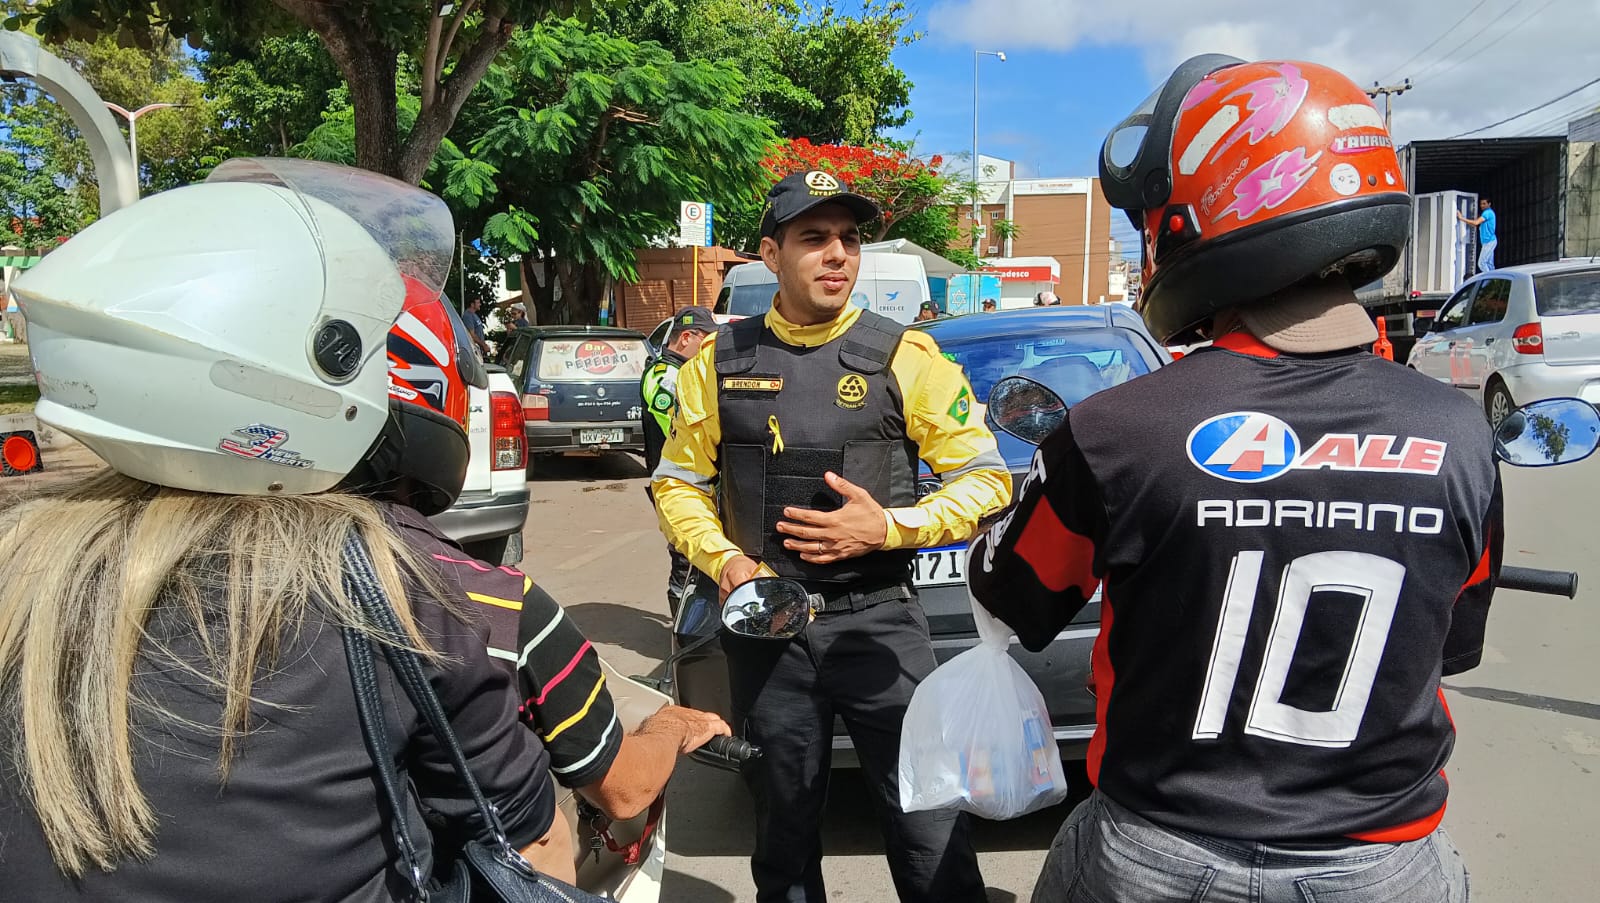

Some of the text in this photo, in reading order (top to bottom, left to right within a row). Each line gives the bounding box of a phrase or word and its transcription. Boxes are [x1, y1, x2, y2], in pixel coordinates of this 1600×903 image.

[1335, 135, 1392, 151] TAURUS
[690, 207, 697, 216] E
[993, 270, 1030, 278] adesco
[585, 343, 606, 351] Bar
[1300, 434, 1447, 475] ALE
[1196, 499, 1445, 534] ADRIANO
[1192, 550, 1407, 748] 10
